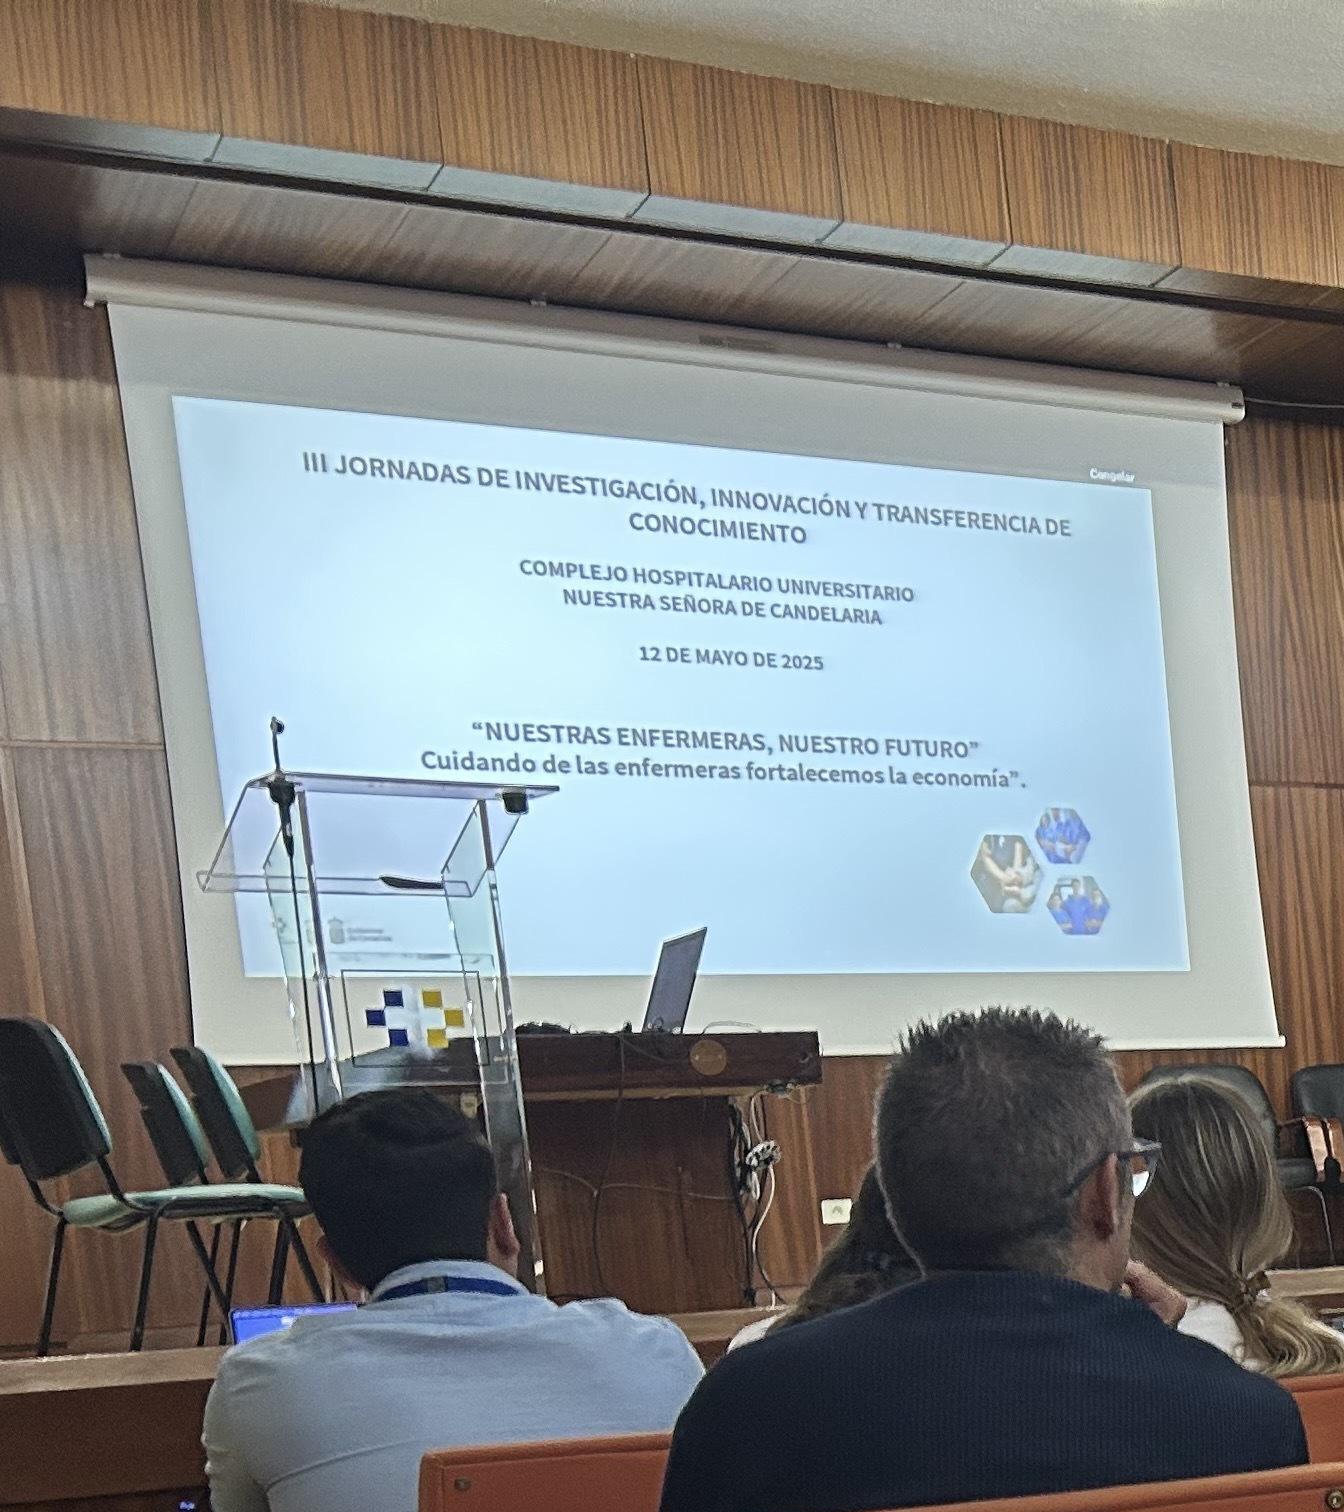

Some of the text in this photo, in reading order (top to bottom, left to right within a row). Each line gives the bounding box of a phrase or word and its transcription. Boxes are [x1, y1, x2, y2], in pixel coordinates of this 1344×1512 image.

[302, 451, 1073, 537] III JORNADAS DE INVESTIGACIÓN, INNOVACIÓN Y TRANSFERENCIA DE
[628, 511, 808, 545] CONOCIMIENTO
[519, 559, 916, 603] COMPLEJO HOSPITALARIO UNIVERSITARIO
[562, 588, 884, 626] NUESTRA SEÑORA DE CANDELARIA
[639, 646, 825, 672] 12 DE MAYO DE 2025
[617, 727, 773, 756] ENFERMERAS,
[778, 734, 880, 757] NUESTRO
[420, 750, 538, 775] Cuidando
[542, 754, 571, 775] de
[576, 754, 609, 776] las
[614, 757, 741, 780] enfermeras
[746, 760, 885, 785] fortalecemos
[888, 765, 908, 785] la
